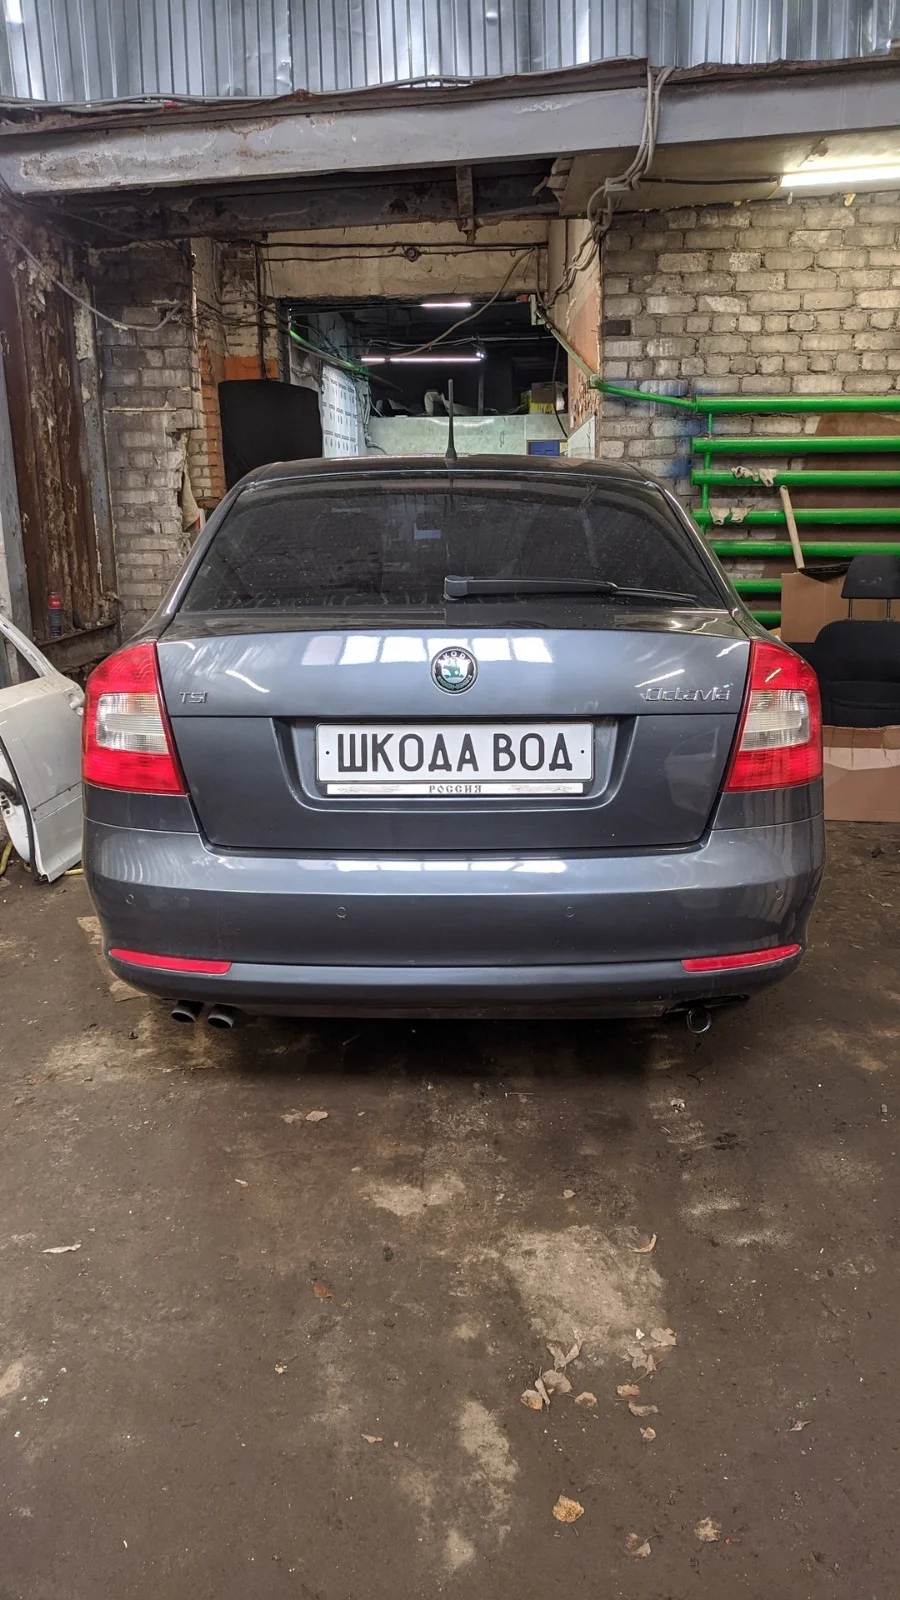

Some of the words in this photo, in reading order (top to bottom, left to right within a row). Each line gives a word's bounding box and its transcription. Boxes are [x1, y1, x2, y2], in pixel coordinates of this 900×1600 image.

[179, 691, 208, 703] TSI
[644, 687, 731, 701] Octavia
[337, 733, 480, 772] ШКОДА
[493, 732, 573, 772] ВОД
[428, 784, 482, 794] РОССИЯ
